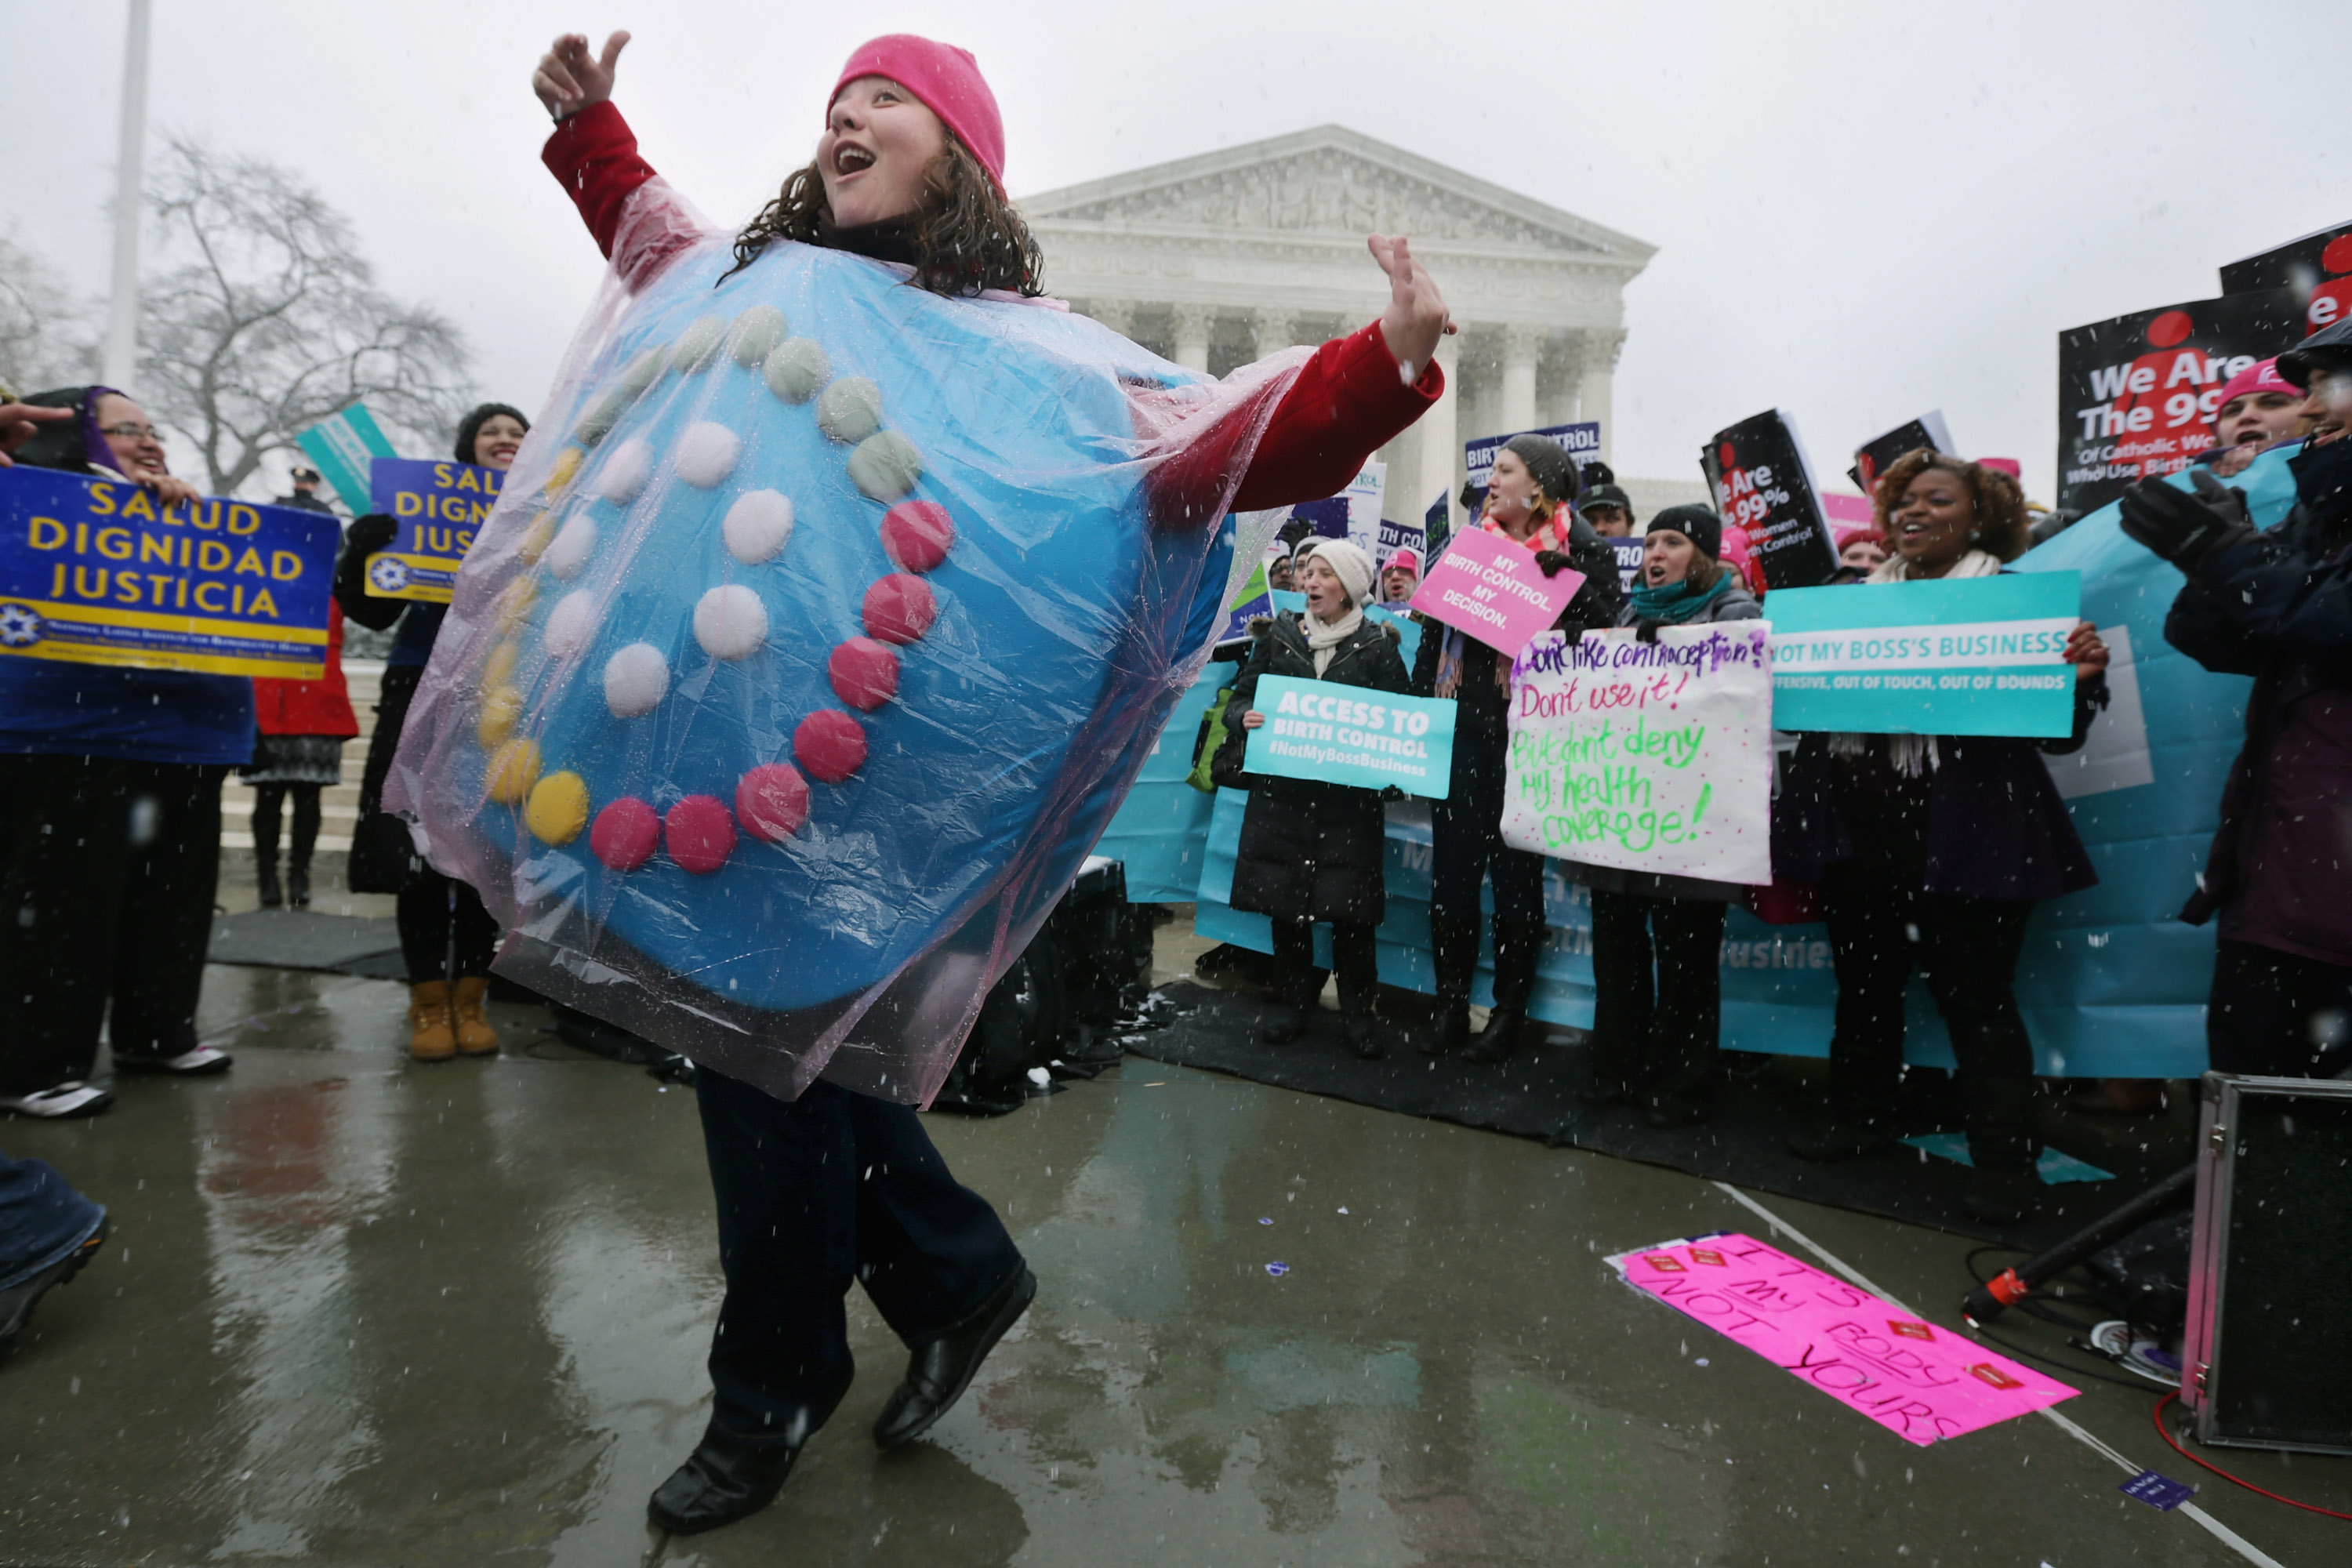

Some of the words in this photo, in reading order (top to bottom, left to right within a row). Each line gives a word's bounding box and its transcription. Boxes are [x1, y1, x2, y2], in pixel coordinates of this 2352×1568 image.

[2089, 362, 2156, 401] We
[2164, 352, 2256, 389] Are
[1554, 429, 1599, 451] TROL
[2077, 403, 2154, 441] The
[2078, 446, 2100, 465] Of
[2100, 438, 2178, 461] Catholic
[434, 463, 508, 495] SAL
[1733, 465, 1773, 499] Are
[2067, 467, 2103, 485] Who
[2107, 463, 2140, 479] Use
[89, 482, 261, 535] SALUD
[1737, 486, 1791, 526] 99%
[27, 516, 303, 581] DIGNIDAD
[1749, 518, 1798, 541] Women
[1763, 526, 1813, 554] Control
[1444, 552, 1483, 577] BIRTH
[1482, 568, 1552, 613] CONTROL.
[1493, 554, 1519, 573] MY
[50, 563, 279, 618] JUSTICIA
[1443, 589, 1507, 630] DECISION.
[1472, 584, 1498, 603] MY
[1811, 641, 1844, 662] MY
[1850, 637, 1932, 660] BOSS'S
[1940, 630, 2067, 658] BUSINESS
[1521, 677, 1583, 718] Don't
[1590, 682, 1637, 710] use
[1639, 671, 1690, 710] it!
[1833, 675, 1861, 689] OUT
[1863, 675, 1882, 688] OF
[1884, 674, 1936, 690] TOUCH,
[1939, 674, 1970, 689] OUT
[1972, 674, 1994, 689] OF
[1996, 674, 2067, 690] BOUNDS
[1276, 691, 1387, 731] ACCESS
[1390, 709, 1431, 736] TO
[1273, 717, 1333, 742] BIRTH
[1337, 727, 1429, 759] CONTROL
[1512, 728, 1561, 770] But
[1624, 714, 1706, 769] deny
[1269, 740, 1428, 778] #NotMyBossBusiness
[1562, 763, 1652, 813] health
[1718, 932, 1835, 970] usine
[1728, 1279, 1808, 1313] MY
[1825, 1322, 1959, 1389] BODY
[1638, 1278, 1781, 1331] NOT
[1782, 1343, 1962, 1442] YOURS
